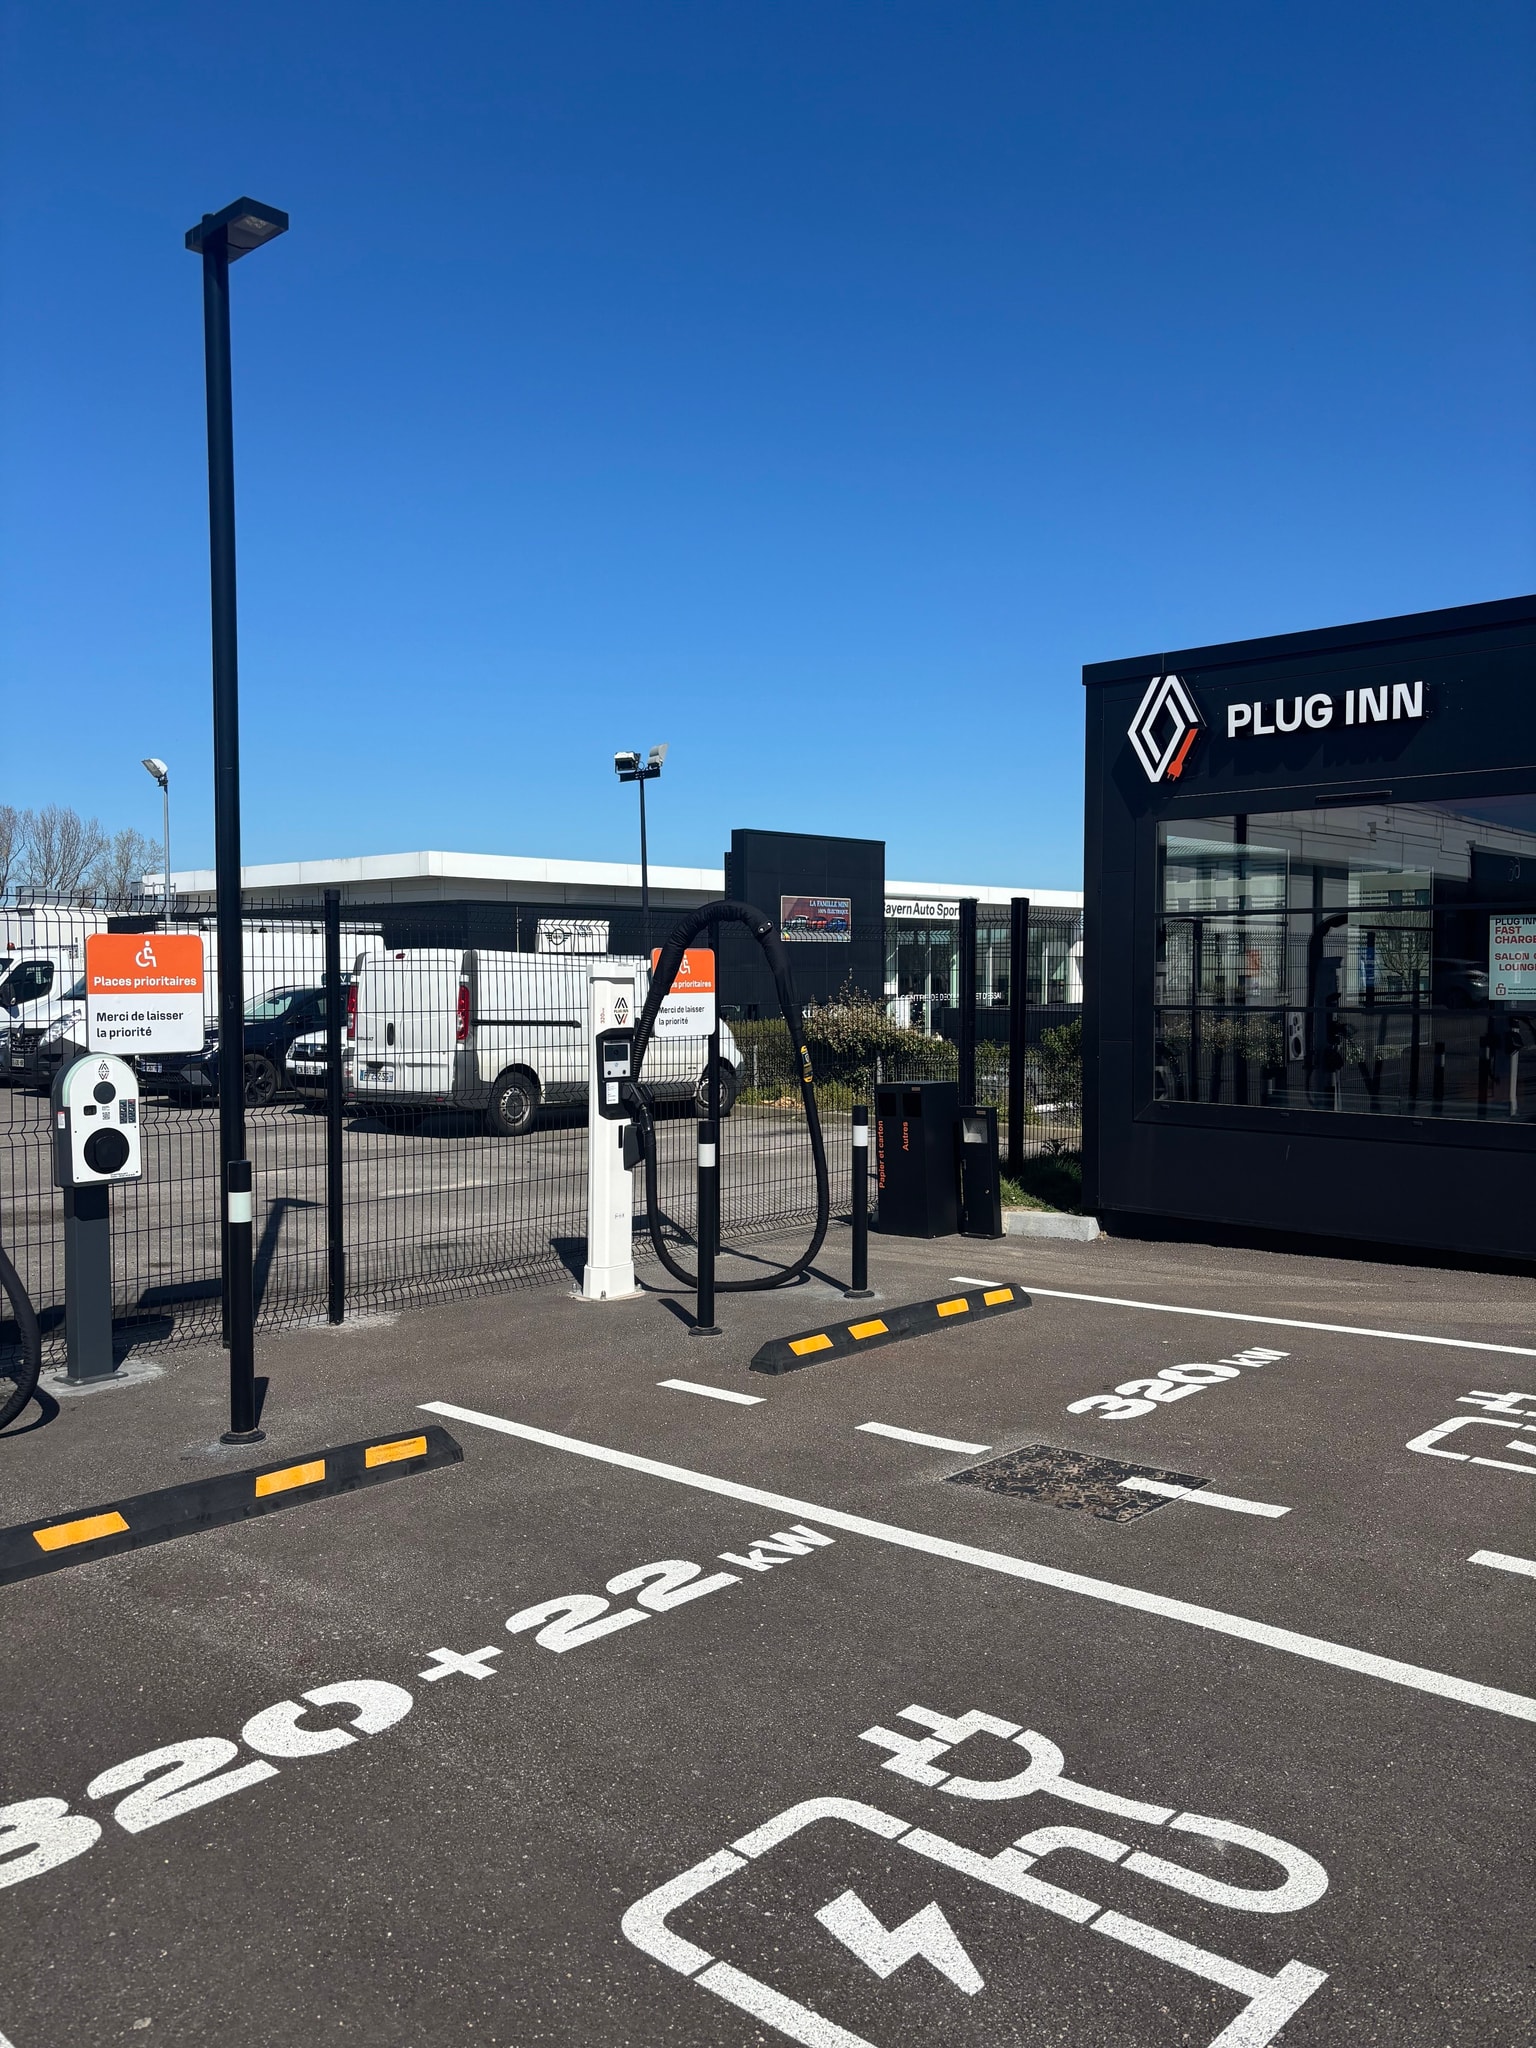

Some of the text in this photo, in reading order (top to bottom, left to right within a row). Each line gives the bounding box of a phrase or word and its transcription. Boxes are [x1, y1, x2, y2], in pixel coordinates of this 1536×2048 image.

[1227, 681, 1423, 738] PLUG INN
[885, 904, 912, 917] ayern
[913, 902, 935, 916] Auto
[1495, 917, 1520, 926] PLUG
[1495, 926, 1522, 935] FAST
[1494, 952, 1529, 961] SALON
[93, 976, 197, 988] Places prioritaires
[678, 980, 712, 989] prioritaires
[96, 1010, 184, 1022] Merci de laisser
[665, 1017, 689, 1026] priorité
[96, 1026, 152, 1040] la priorité
[878, 1149, 885, 1159] et
[1066, 1346, 1291, 1419] 320 kW
[418, 1645, 503, 1681] +
[505, 1559, 742, 1654] 22
[717, 1524, 836, 1571] kW
